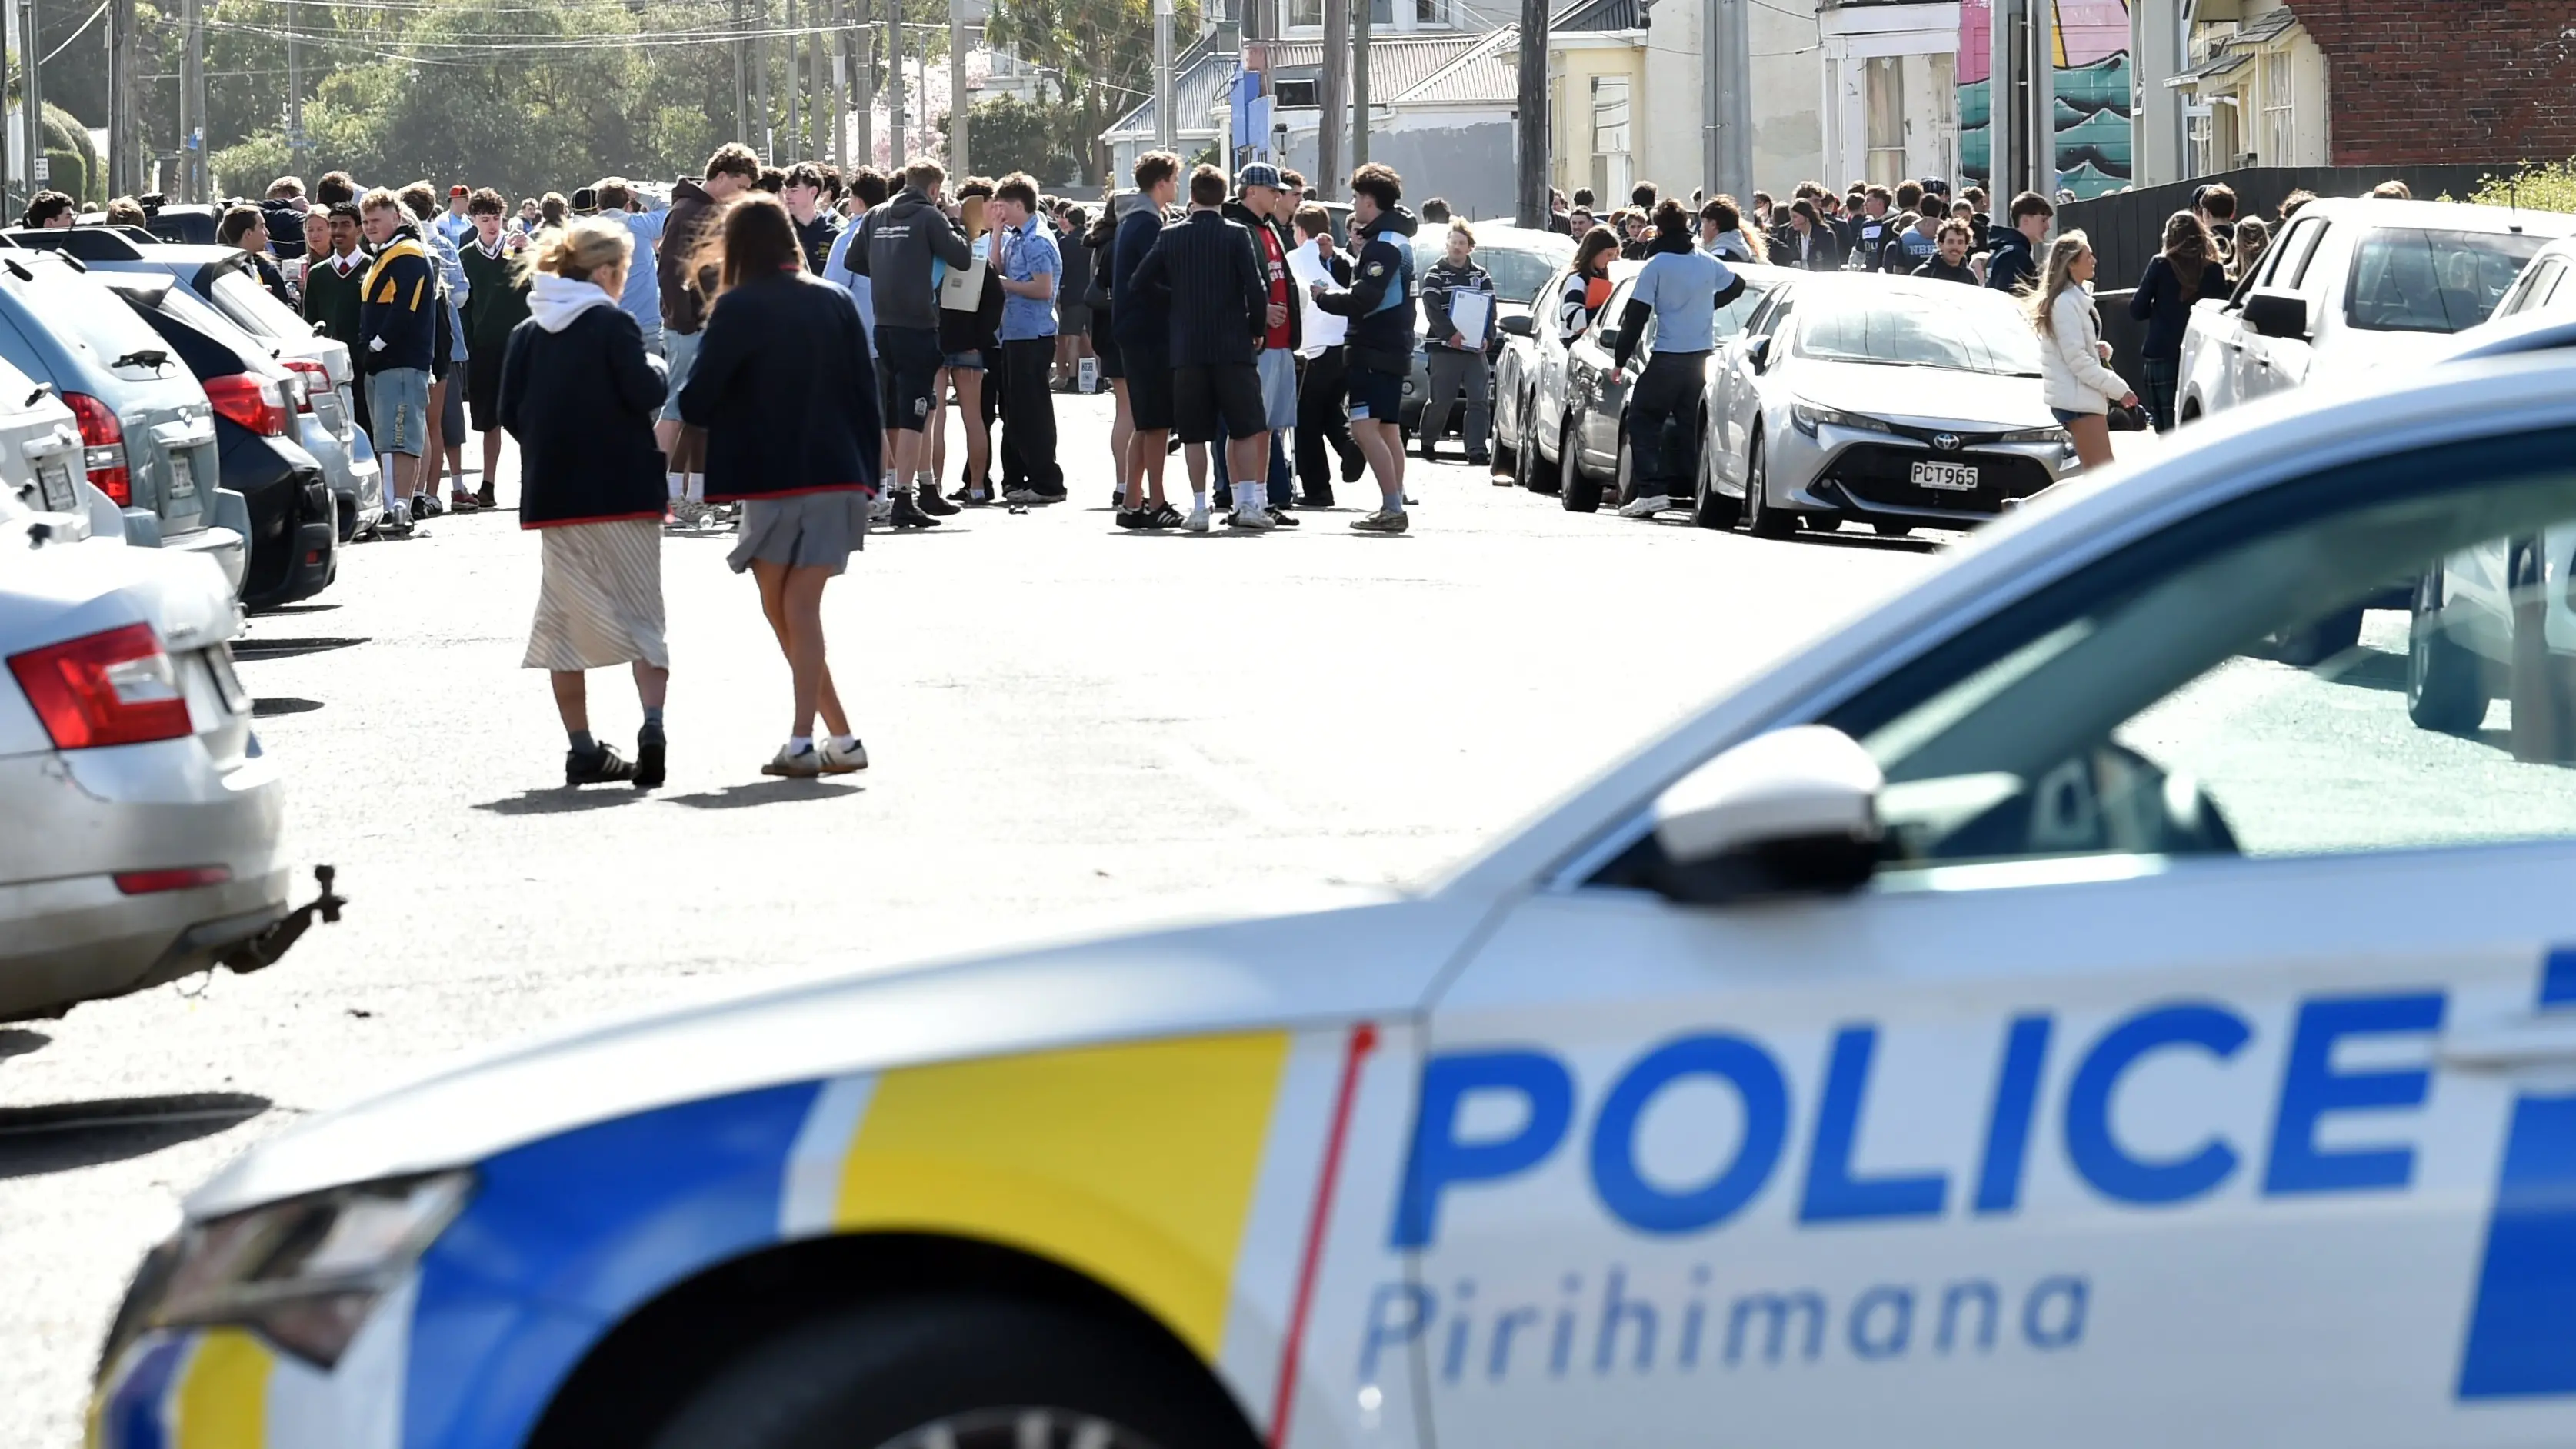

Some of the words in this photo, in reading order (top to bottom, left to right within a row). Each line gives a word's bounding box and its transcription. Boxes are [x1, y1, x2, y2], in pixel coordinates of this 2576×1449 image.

[1913, 465, 1976, 485] PCT965
[1388, 989, 2449, 1249] POLICE
[1358, 1265, 2089, 1382] Pirihimana
